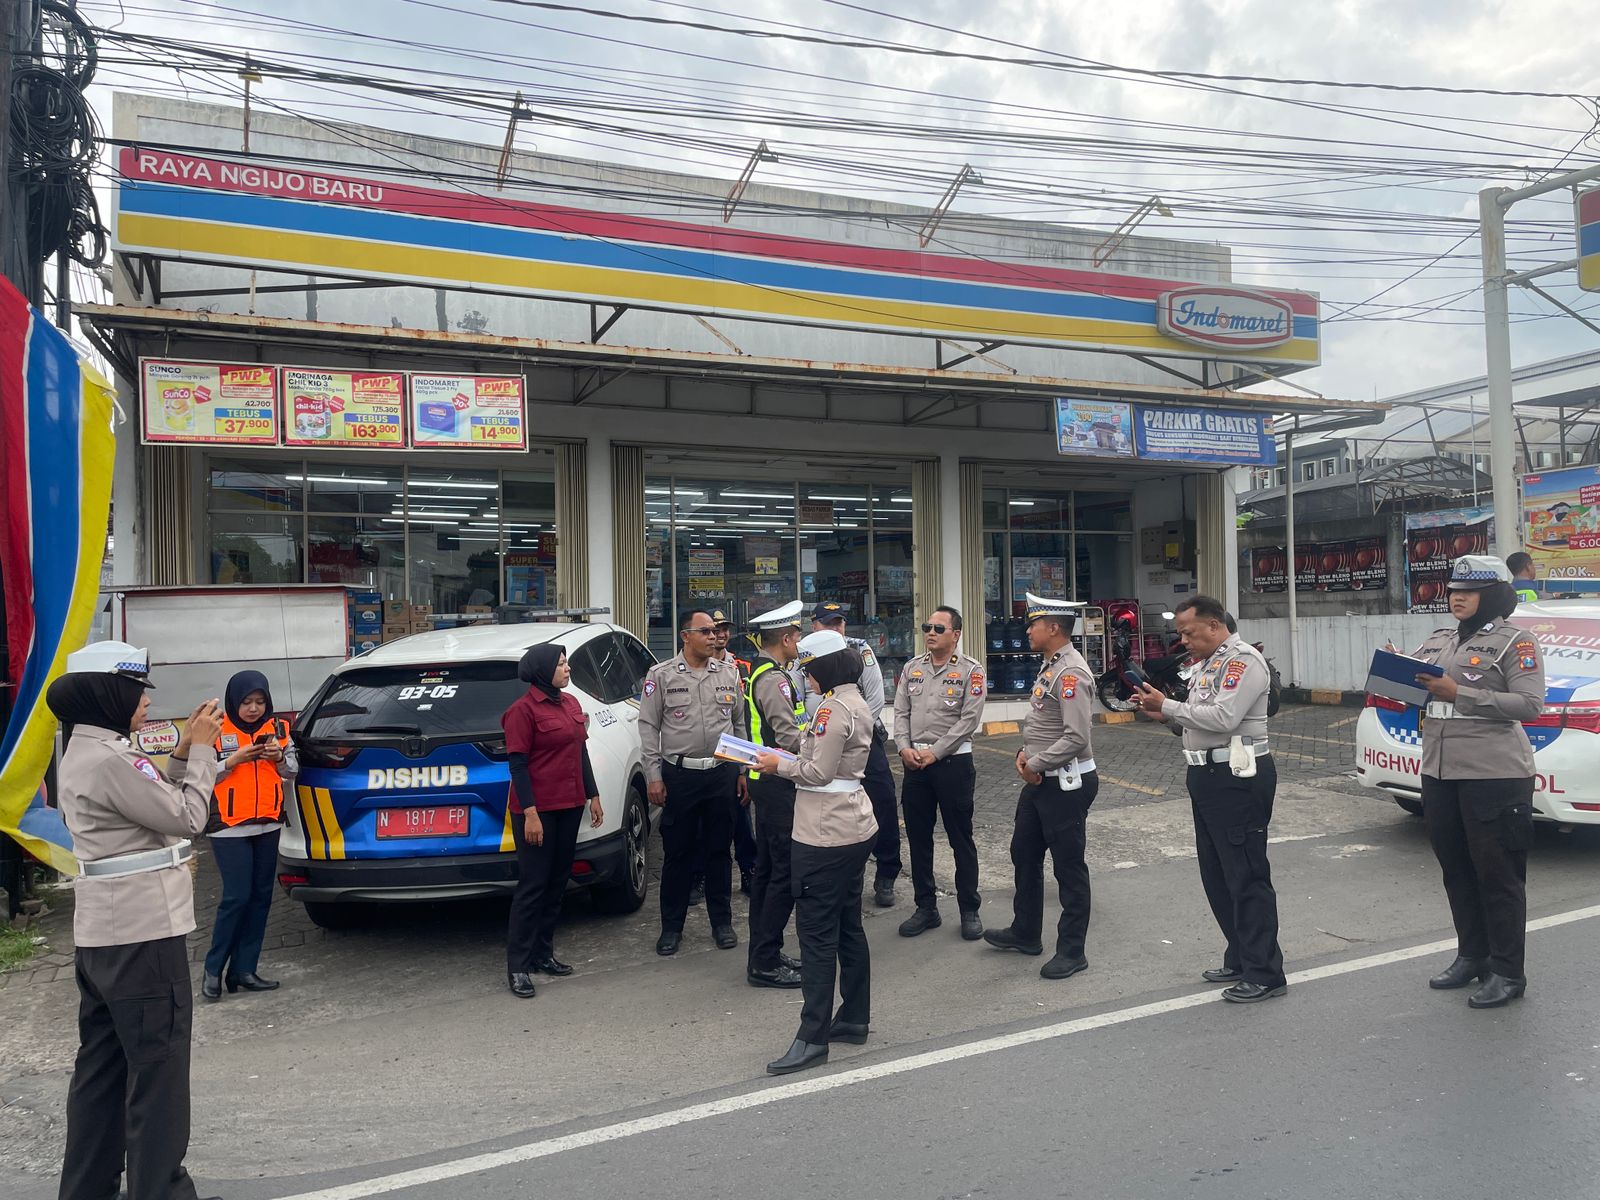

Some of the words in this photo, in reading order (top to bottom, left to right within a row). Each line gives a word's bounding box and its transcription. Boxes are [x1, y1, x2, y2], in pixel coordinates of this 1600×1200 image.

[140, 154, 212, 181] RAYA
[220, 165, 304, 192] NGIJO
[312, 177, 383, 202] BARU
[1176, 300, 1284, 333] Indomaret
[149, 366, 182, 374] SUNCO
[230, 370, 262, 381] PWP
[288, 372, 332, 380] MORINAGA
[362, 378, 390, 388] PWP
[484, 382, 511, 392] PWP
[225, 420, 270, 433] 37.900
[1144, 410, 1202, 430] PARKIR
[1206, 414, 1258, 434] GRATIS
[480, 426, 518, 439] 14.900
[1466, 646, 1497, 655] POLRI
[398, 685, 459, 700] 93-05
[143, 735, 174, 744] KANE
[1364, 746, 1421, 776] HIGHW
[368, 765, 468, 790] DISHUB
[380, 812, 388, 826] N
[406, 810, 435, 826] 1817
[448, 809, 464, 824] FP
